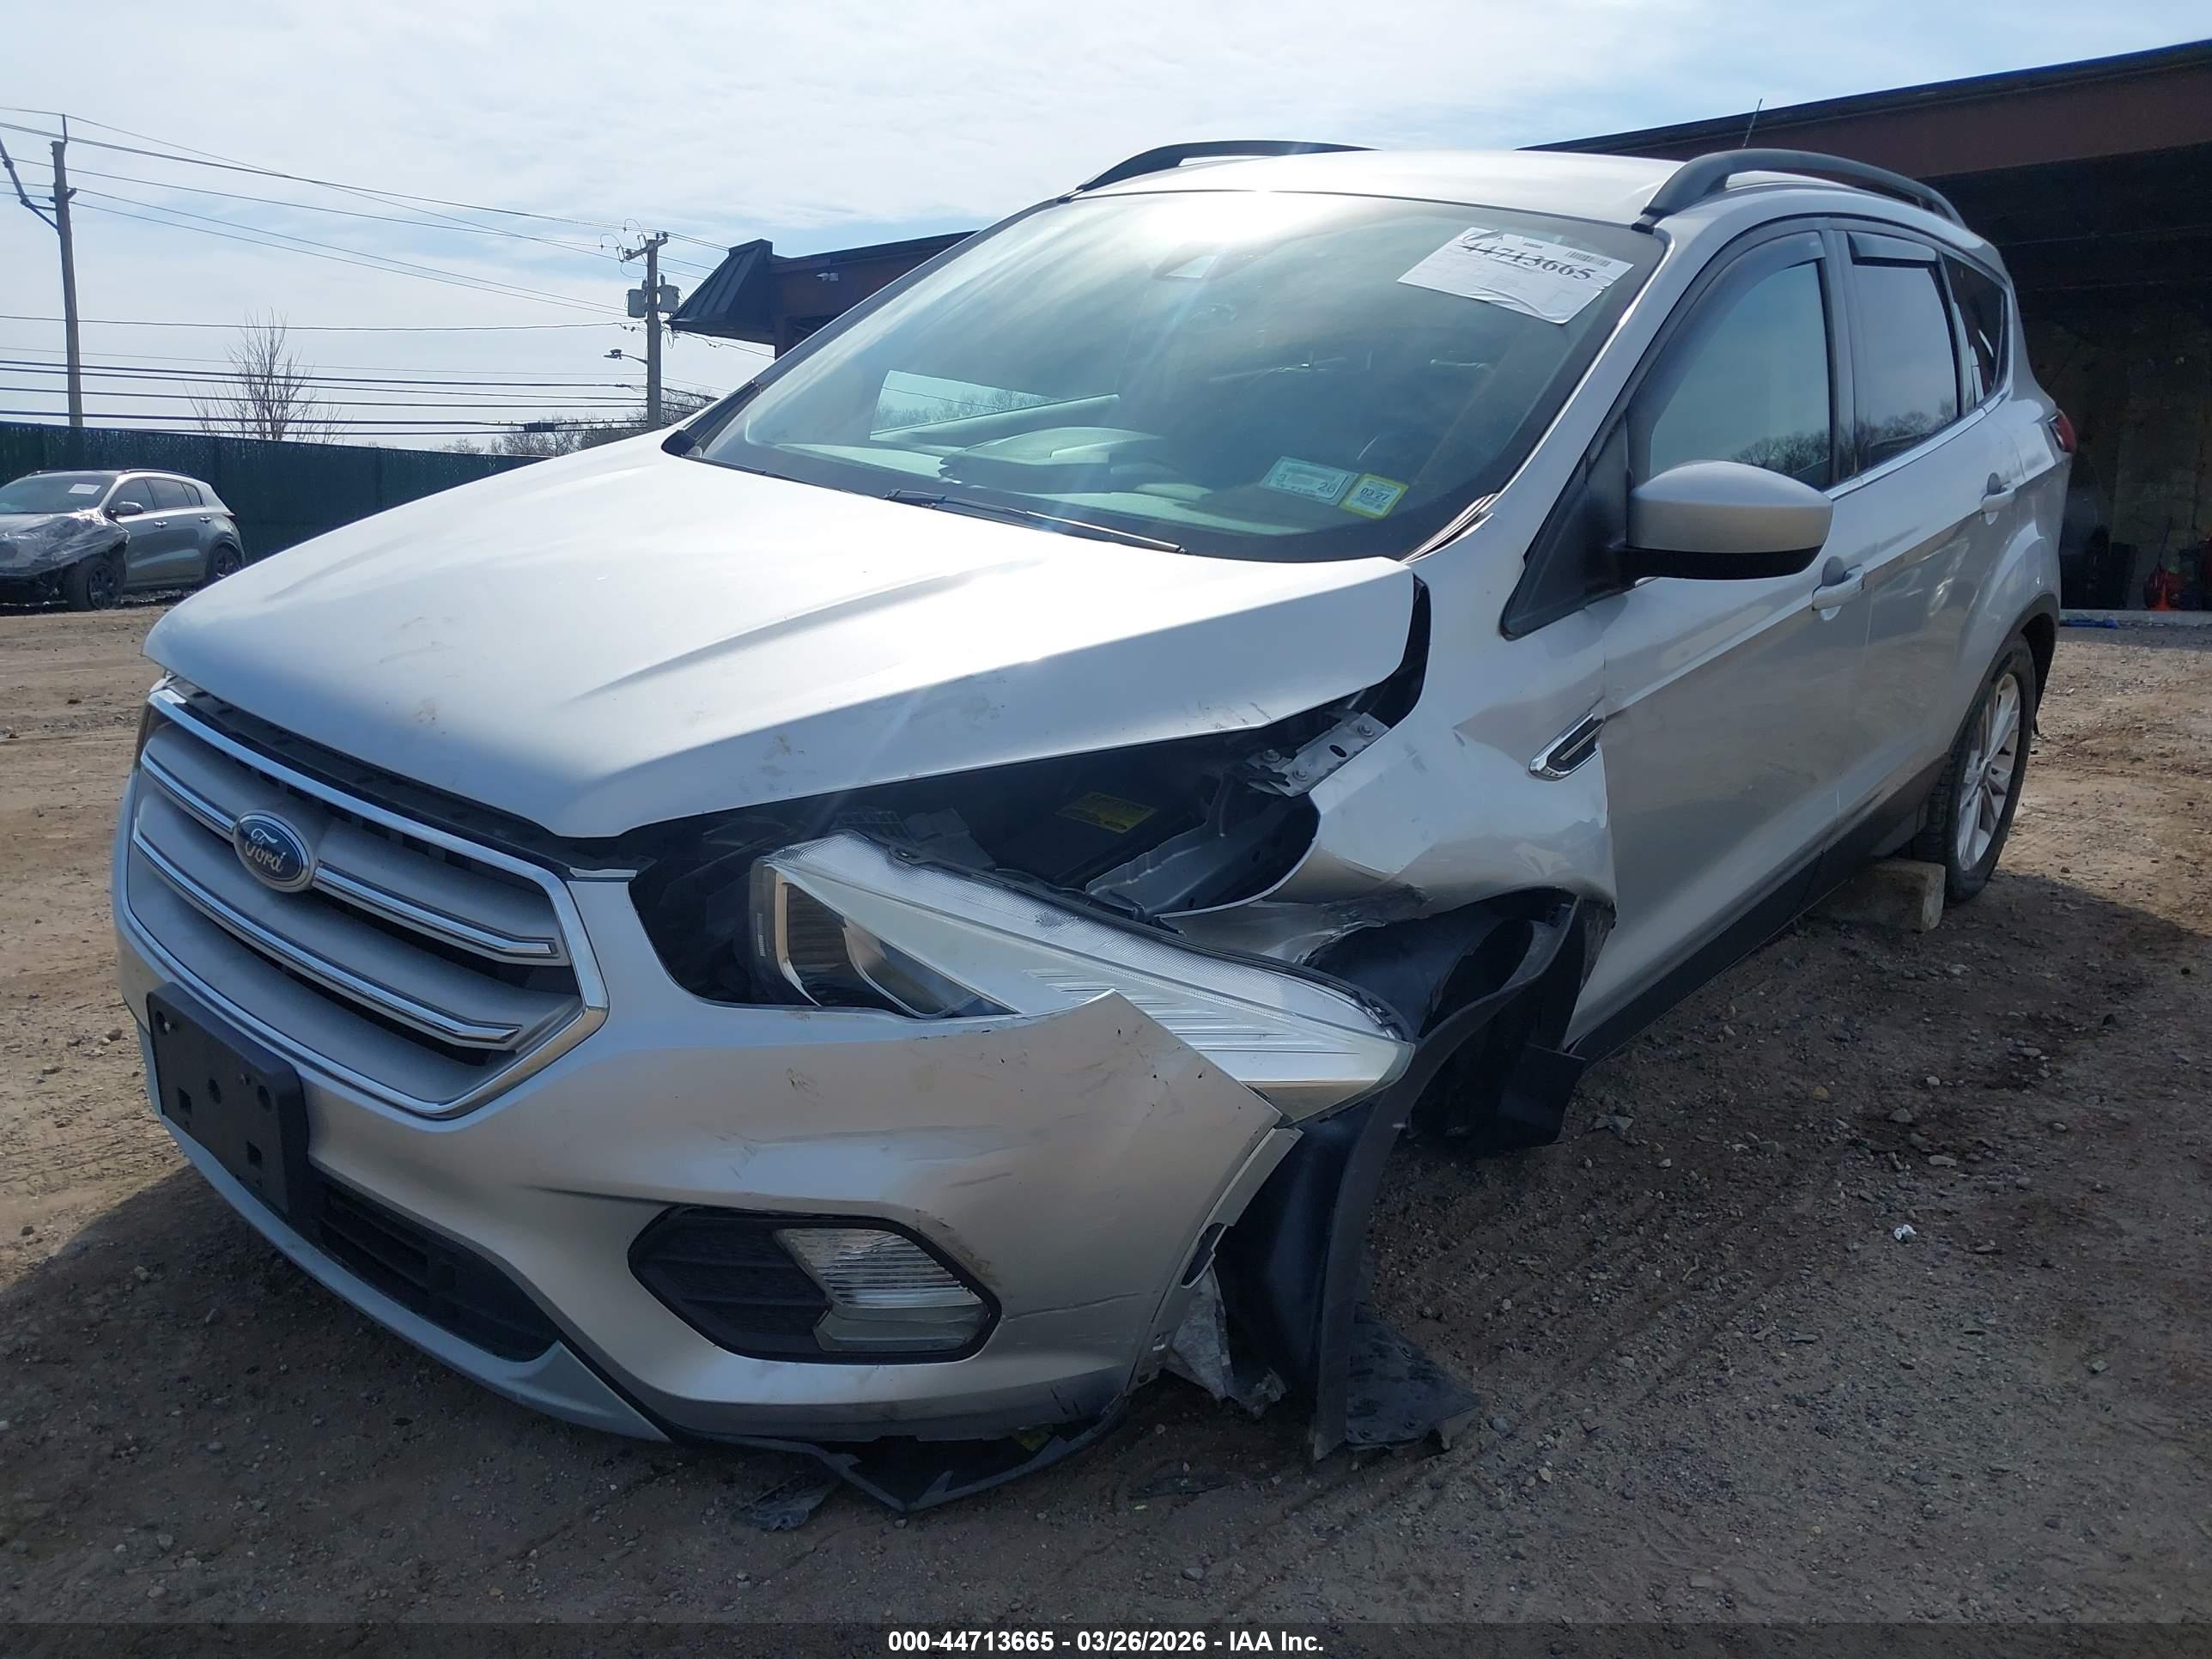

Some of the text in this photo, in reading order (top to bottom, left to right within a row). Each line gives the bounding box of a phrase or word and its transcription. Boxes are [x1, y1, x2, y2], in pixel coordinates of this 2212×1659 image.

[1461, 242, 1596, 280] 44713665
[1360, 487, 1375, 496] 03
[245, 828, 287, 872] Ford
